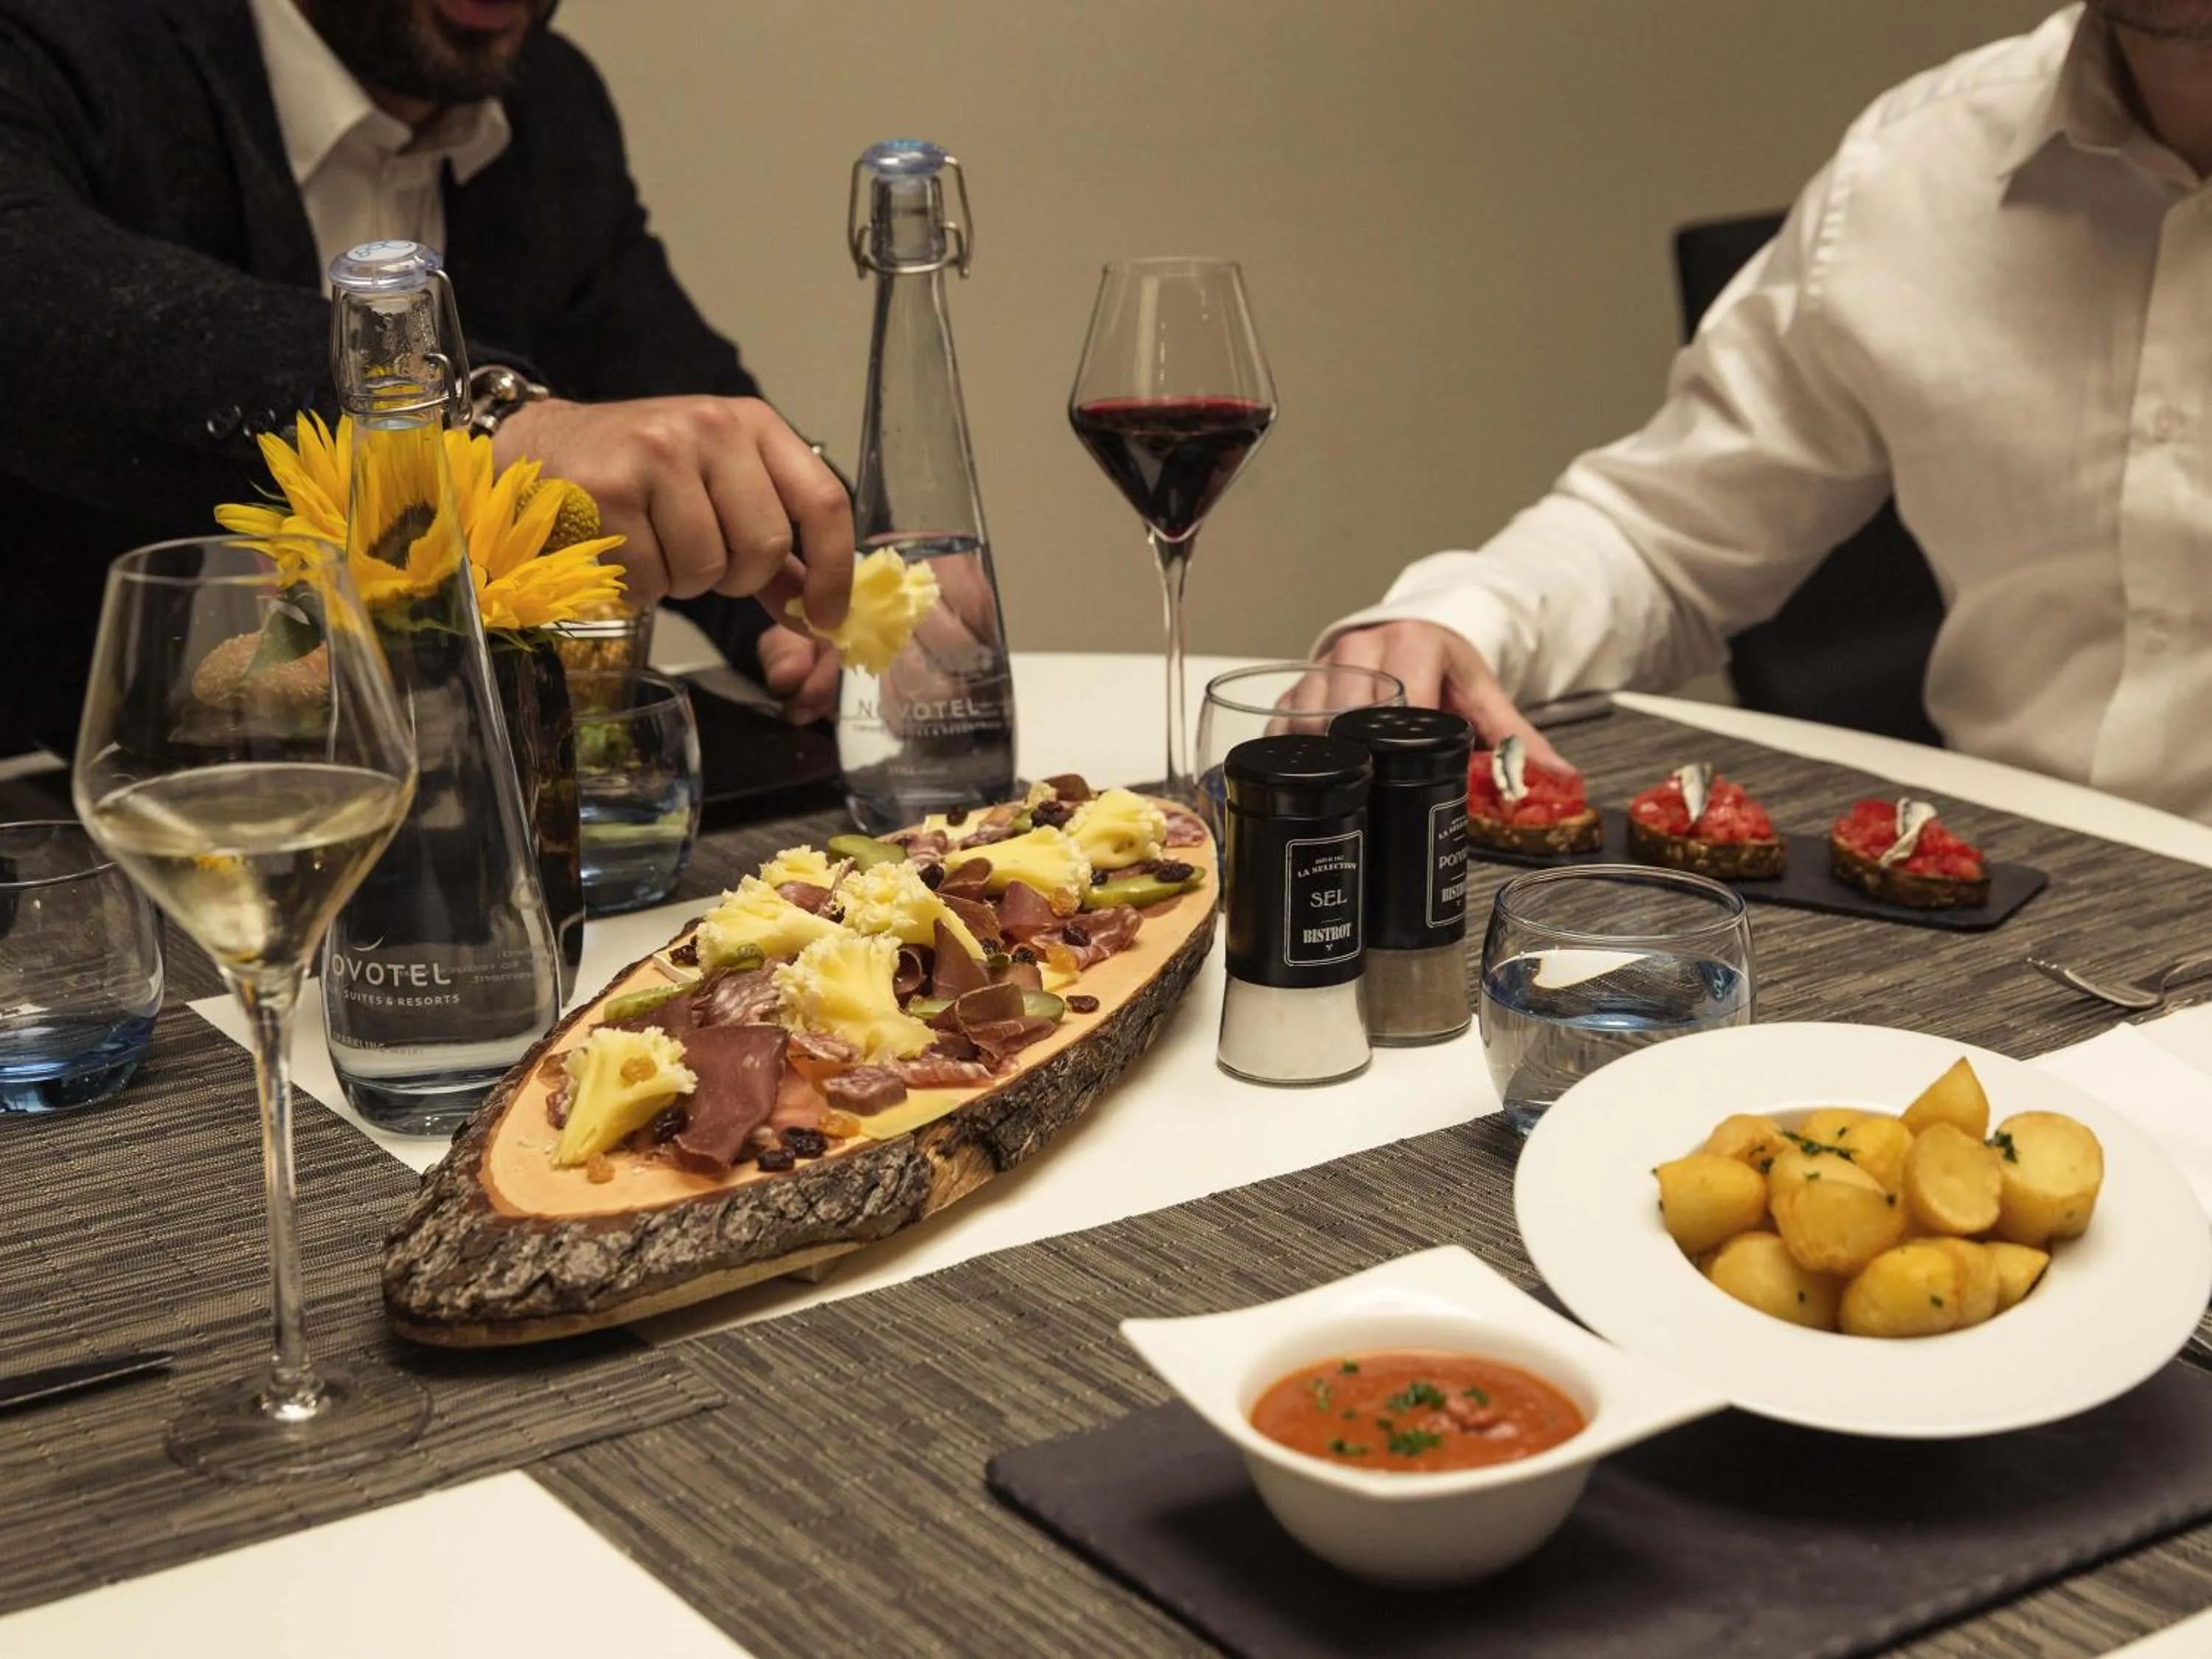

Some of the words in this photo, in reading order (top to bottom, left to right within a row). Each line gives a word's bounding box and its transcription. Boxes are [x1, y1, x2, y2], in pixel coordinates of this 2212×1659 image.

[858, 697, 979, 720] NVOTEL
[1298, 869, 1310, 878] LA
[1310, 889, 1347, 908] SEL
[1303, 922, 1352, 944] BISTROT
[333, 953, 451, 987] OVOTEL
[344, 990, 383, 1005] SUITES
[386, 997, 394, 1006] &
[397, 993, 460, 1006] RESORTS
